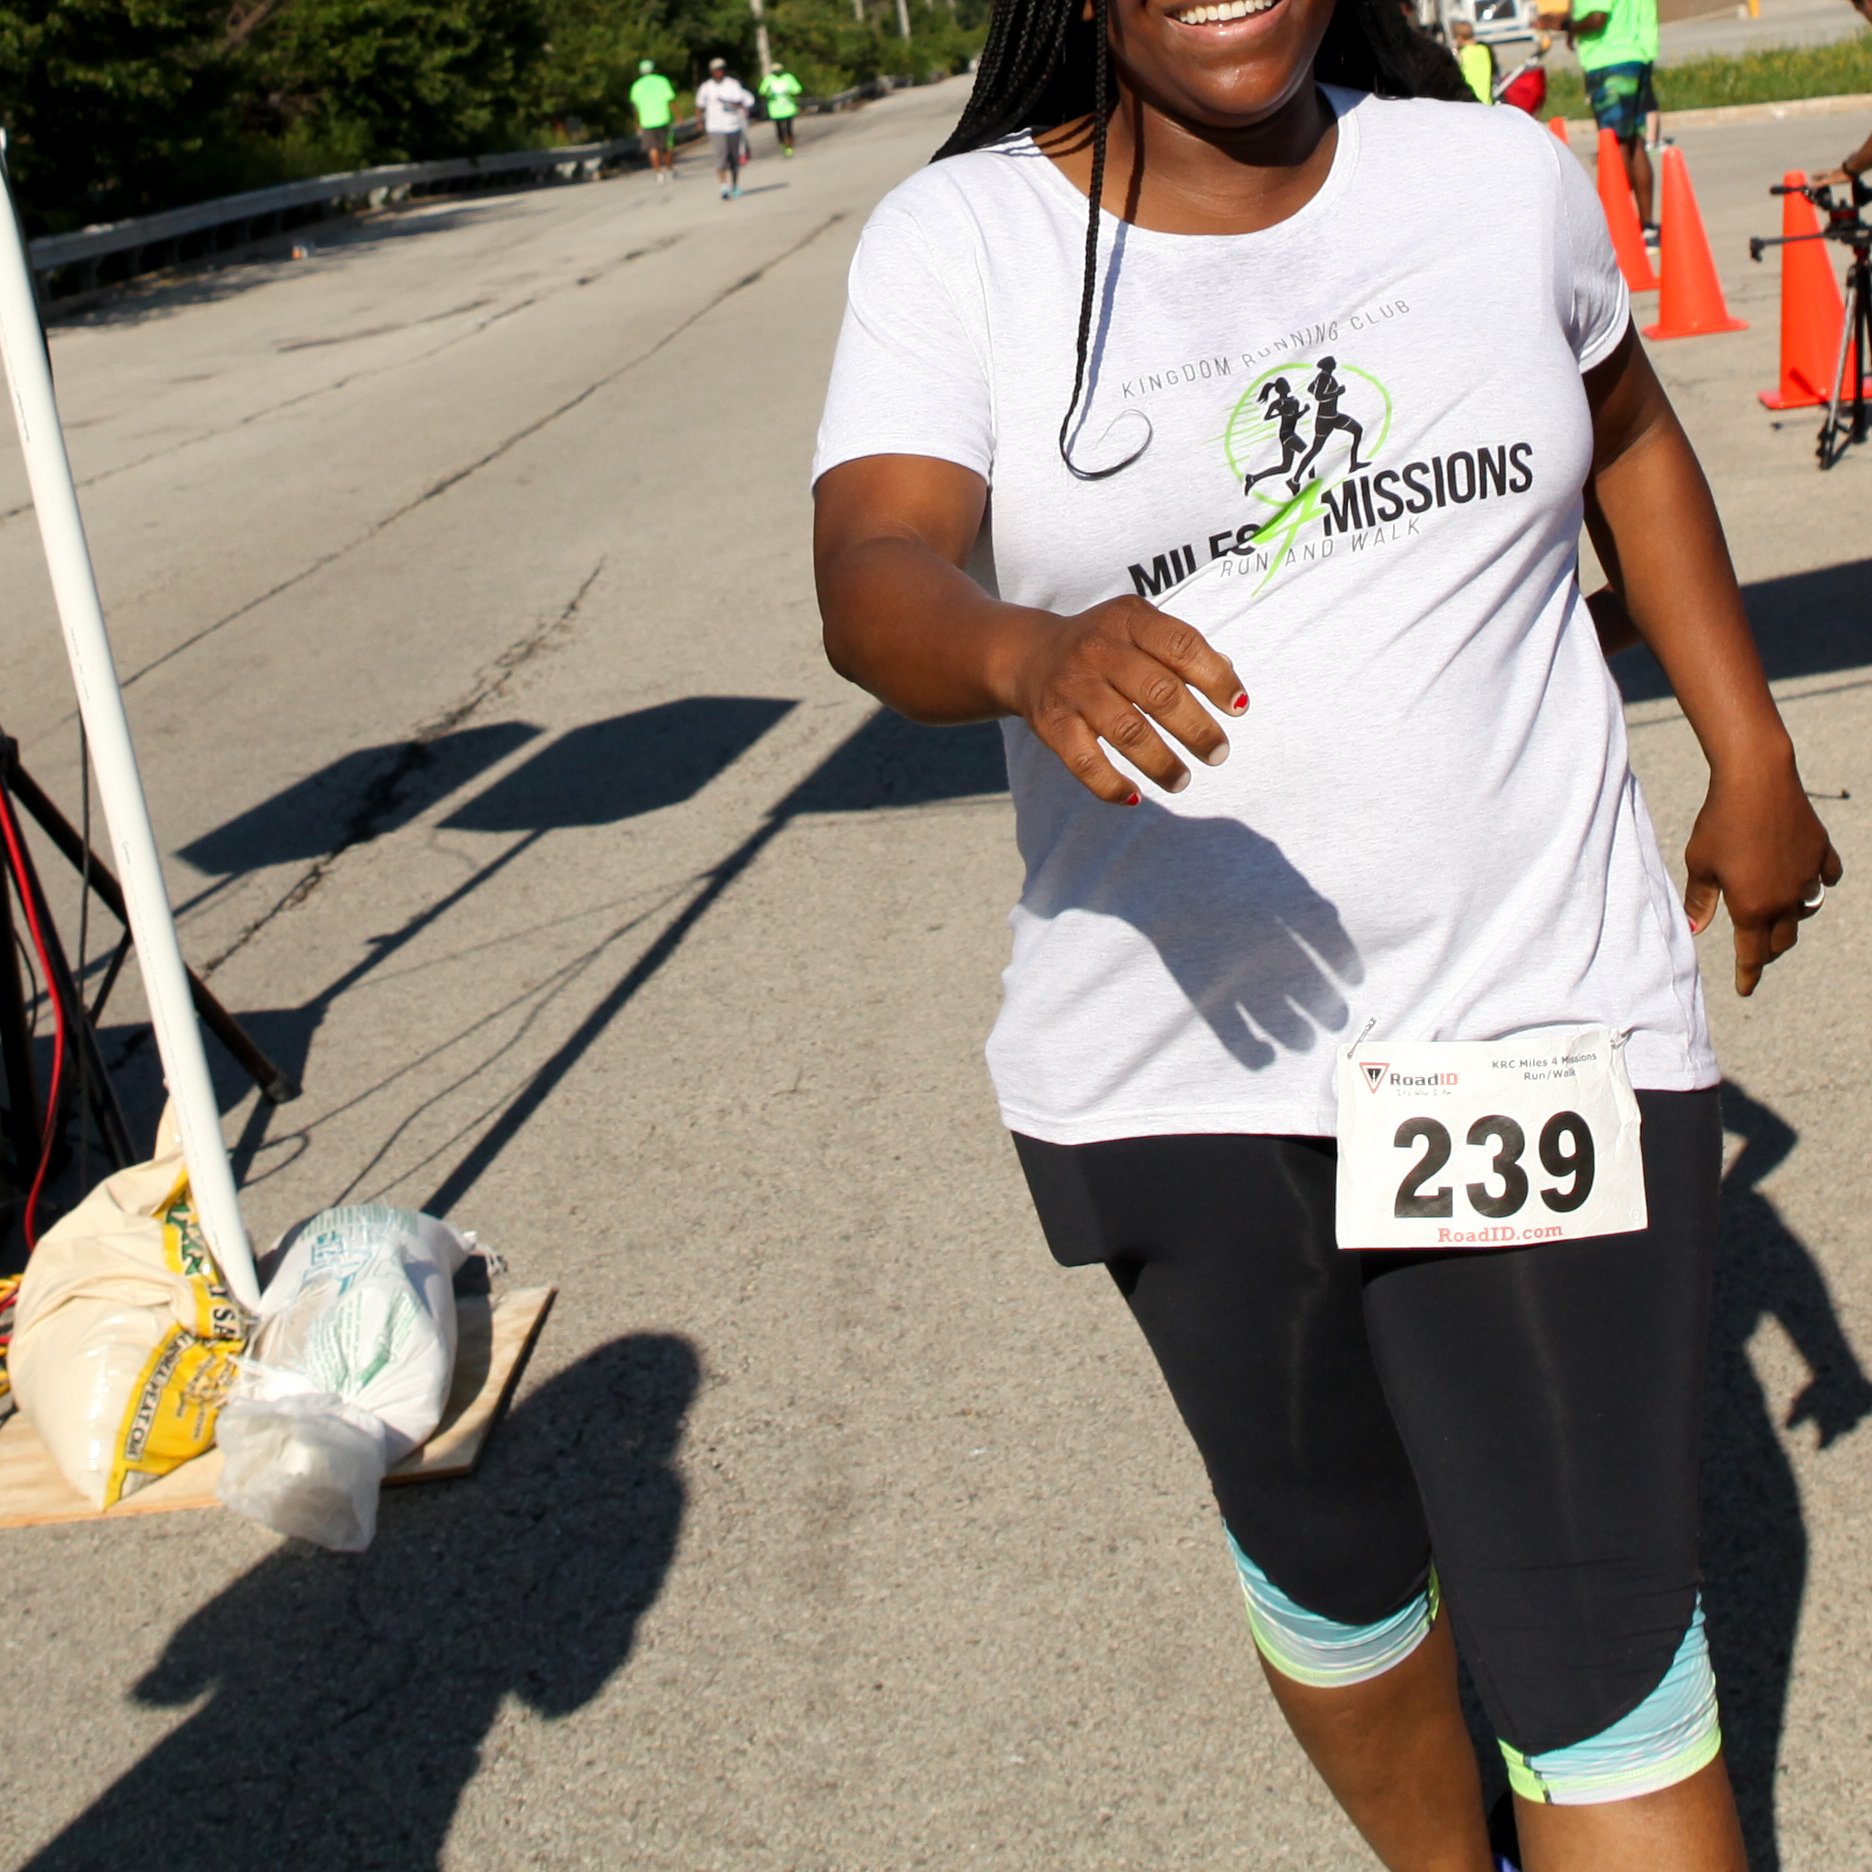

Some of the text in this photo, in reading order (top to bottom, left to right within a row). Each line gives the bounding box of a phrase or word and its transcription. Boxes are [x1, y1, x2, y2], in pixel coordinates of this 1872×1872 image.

[1121, 299, 1411, 399] KINGDOM RUNNING CLUB
[1322, 442, 1533, 536] MISSIONS
[1220, 518, 1422, 578] RUN AND WALK
[1390, 1072, 1459, 1086] RoadID
[1492, 1059, 1516, 1069] KRC
[1519, 1058, 1548, 1068] Miles
[1551, 1057, 1558, 1066] 4
[1524, 1068, 1577, 1081] Run/Walk
[1393, 1110, 1595, 1218] 239
[1437, 1226, 1564, 1243] RoadID.com
